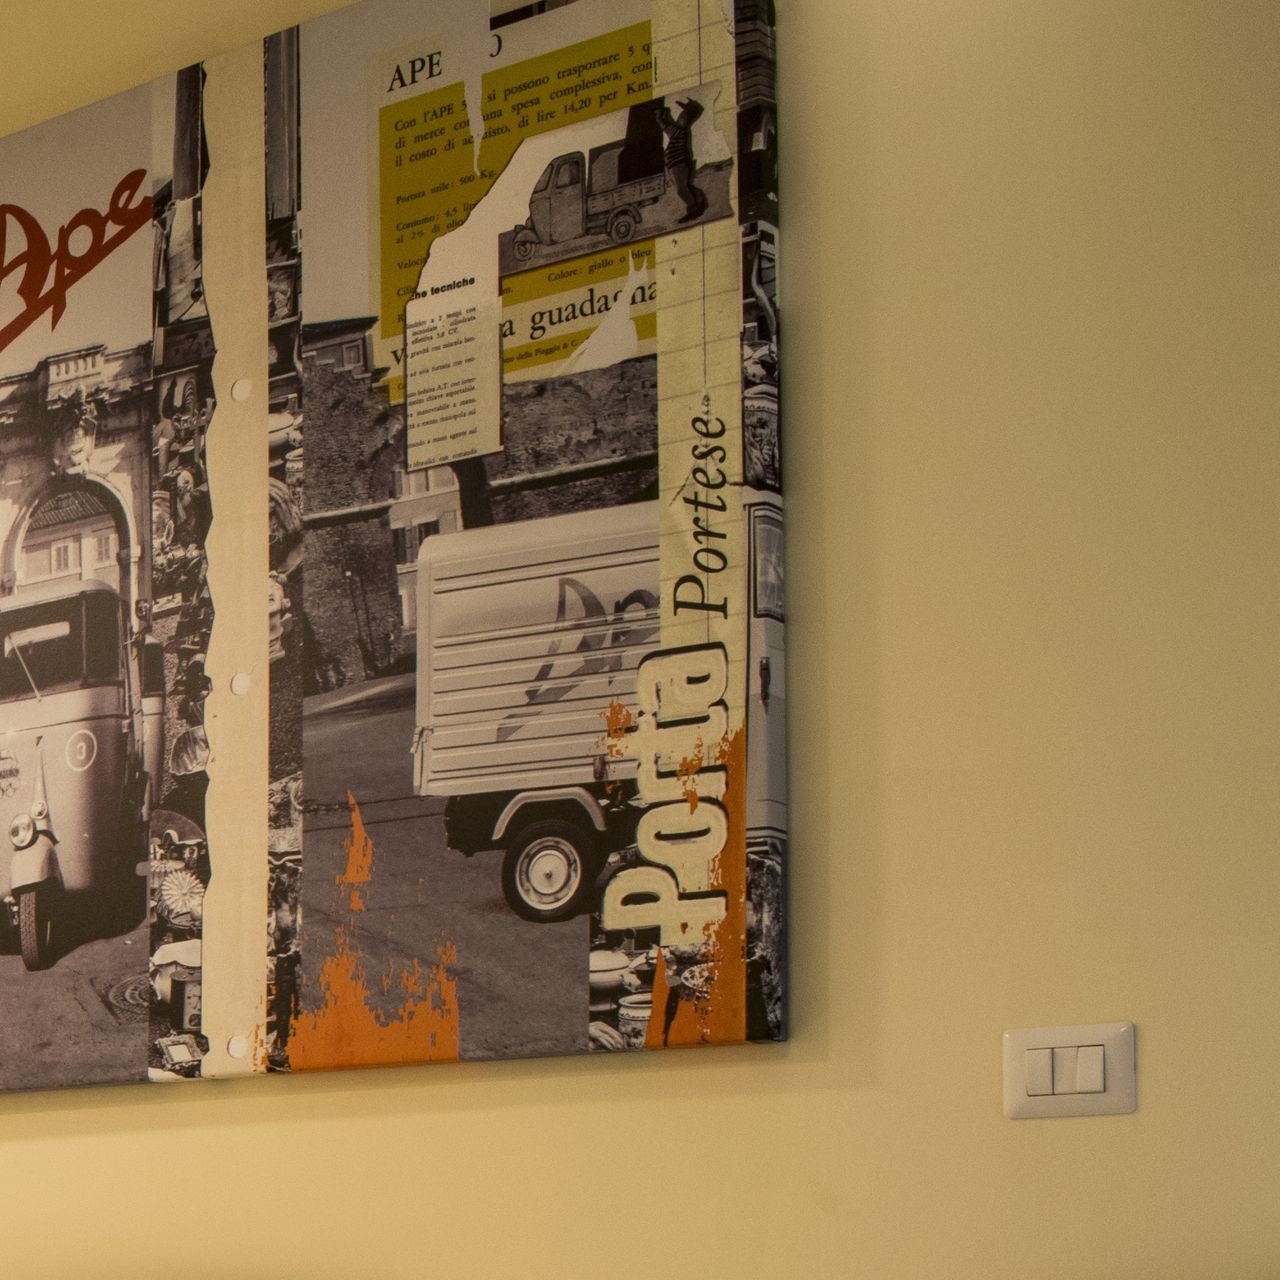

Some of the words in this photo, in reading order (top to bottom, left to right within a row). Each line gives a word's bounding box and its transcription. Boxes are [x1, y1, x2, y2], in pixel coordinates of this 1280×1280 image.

[387, 50, 443, 93] APE
[394, 118, 416, 132] Con
[423, 103, 454, 123] l'APE
[487, 89, 496, 101] si
[504, 76, 550, 101] possono
[556, 53, 621, 83] trasportare
[628, 46, 635, 58] 5
[642, 43, 652, 56] q
[395, 136, 406, 150] di
[414, 127, 446, 144] merce
[511, 97, 540, 115] spesa
[549, 71, 623, 100] complessiva,
[631, 61, 653, 75] con
[395, 155, 403, 168] il
[409, 147, 438, 162] costo
[444, 138, 456, 152] di
[518, 115, 530, 129] di
[537, 107, 558, 122] lire
[563, 97, 592, 115] 14,20
[599, 91, 619, 108] per
[626, 79, 653, 95] Km.
[430, 277, 476, 296] tecniche
[547, 267, 584, 282] Colore:
[588, 258, 614, 275] giallo
[391, 347, 405, 365] V
[499, 318, 516, 339] a
[530, 282, 657, 341] guadana
[601, 640, 728, 949] Porta
[673, 416, 728, 620] Portese
